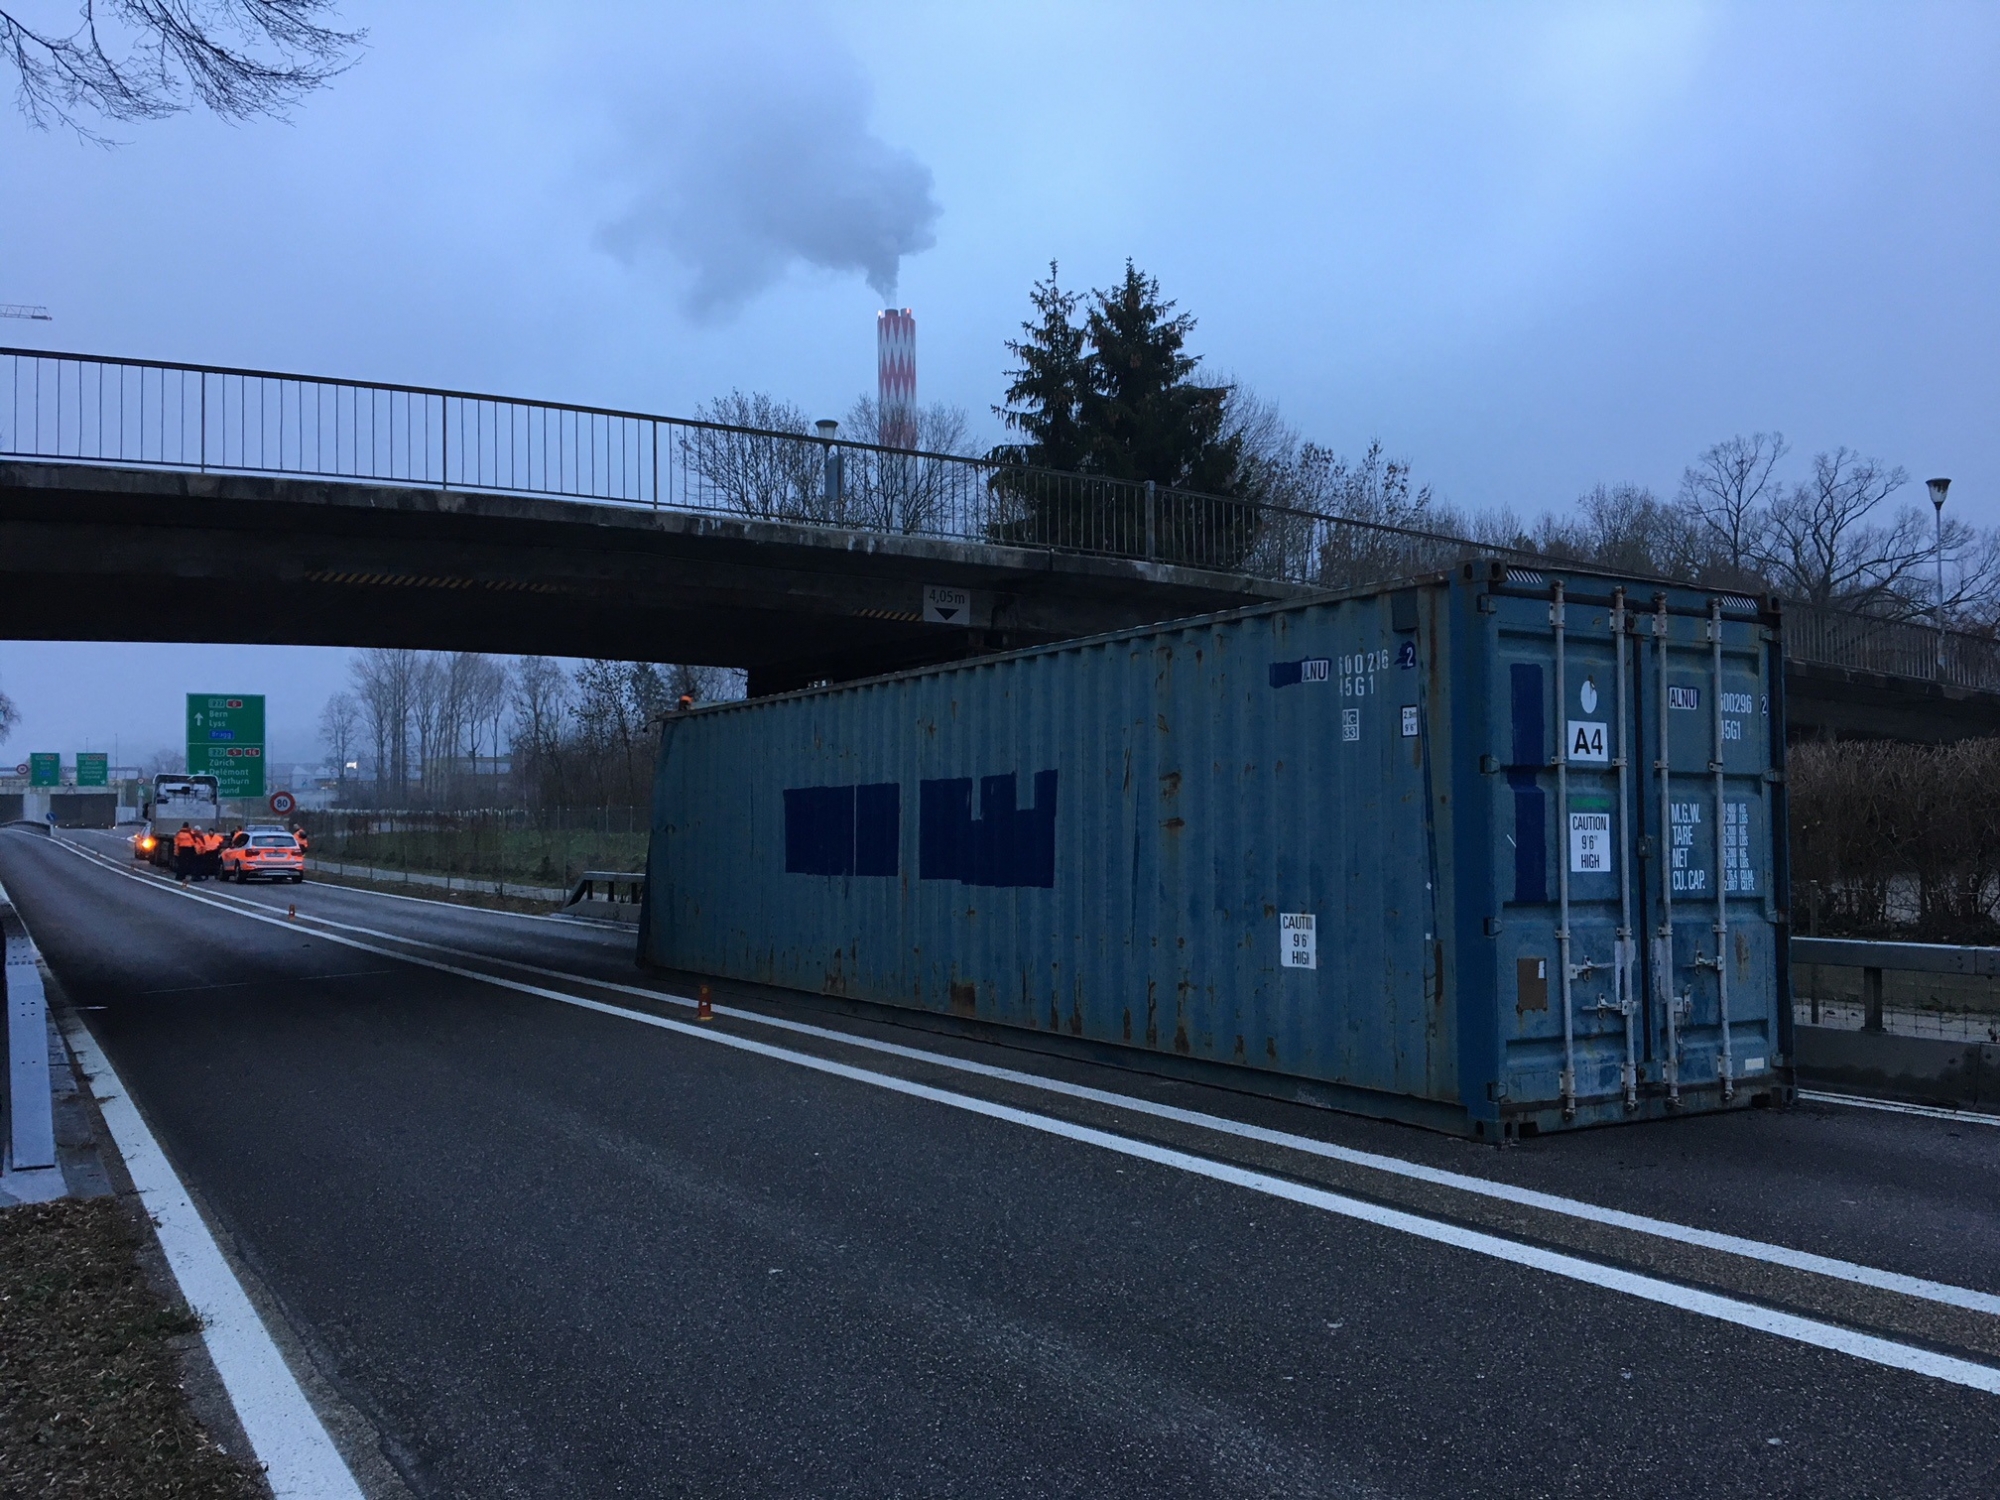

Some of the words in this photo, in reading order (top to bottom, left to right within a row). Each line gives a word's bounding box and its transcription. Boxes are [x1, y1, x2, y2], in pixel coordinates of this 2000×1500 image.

[928, 589, 965, 604] 4,05m
[1406, 647, 1414, 667] 2
[1670, 688, 1696, 709] ALNU
[1761, 695, 1768, 714] 2
[209, 710, 228, 718] Bern
[209, 719, 226, 728] Lyss
[1573, 727, 1604, 755] A4
[209, 758, 235, 767] Zürich
[209, 768, 249, 776] Delémont
[219, 776, 250, 785] lothurn
[219, 786, 240, 795] pund
[276, 799, 288, 808] 80
[1671, 803, 1701, 823] M.G.W.
[1572, 815, 1607, 831] CAUTION
[1672, 825, 1693, 845] TARE
[1580, 853, 1600, 869] HIGH
[1672, 847, 1689, 868] NET
